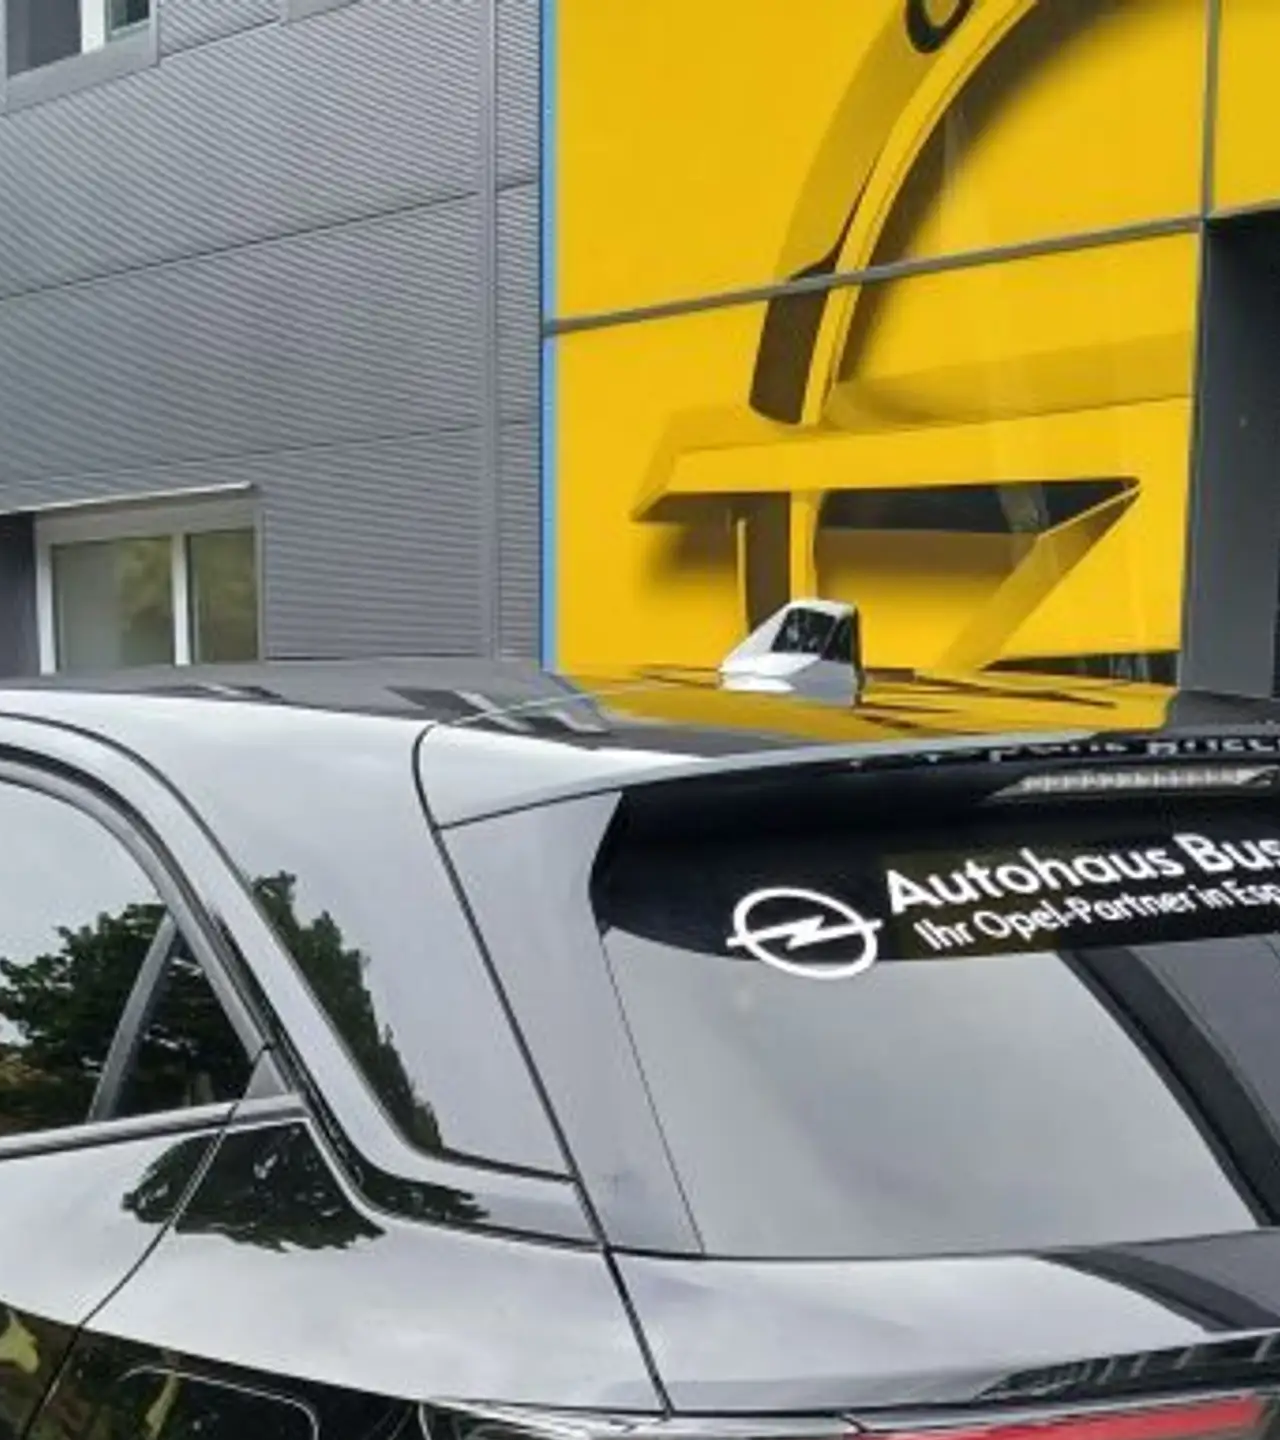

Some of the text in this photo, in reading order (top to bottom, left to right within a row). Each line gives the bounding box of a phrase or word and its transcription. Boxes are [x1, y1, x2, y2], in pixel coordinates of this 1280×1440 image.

[887, 848, 1185, 915] Autohaus
[914, 917, 975, 950] Ihr
[974, 886, 1197, 941] Opel-Partner
